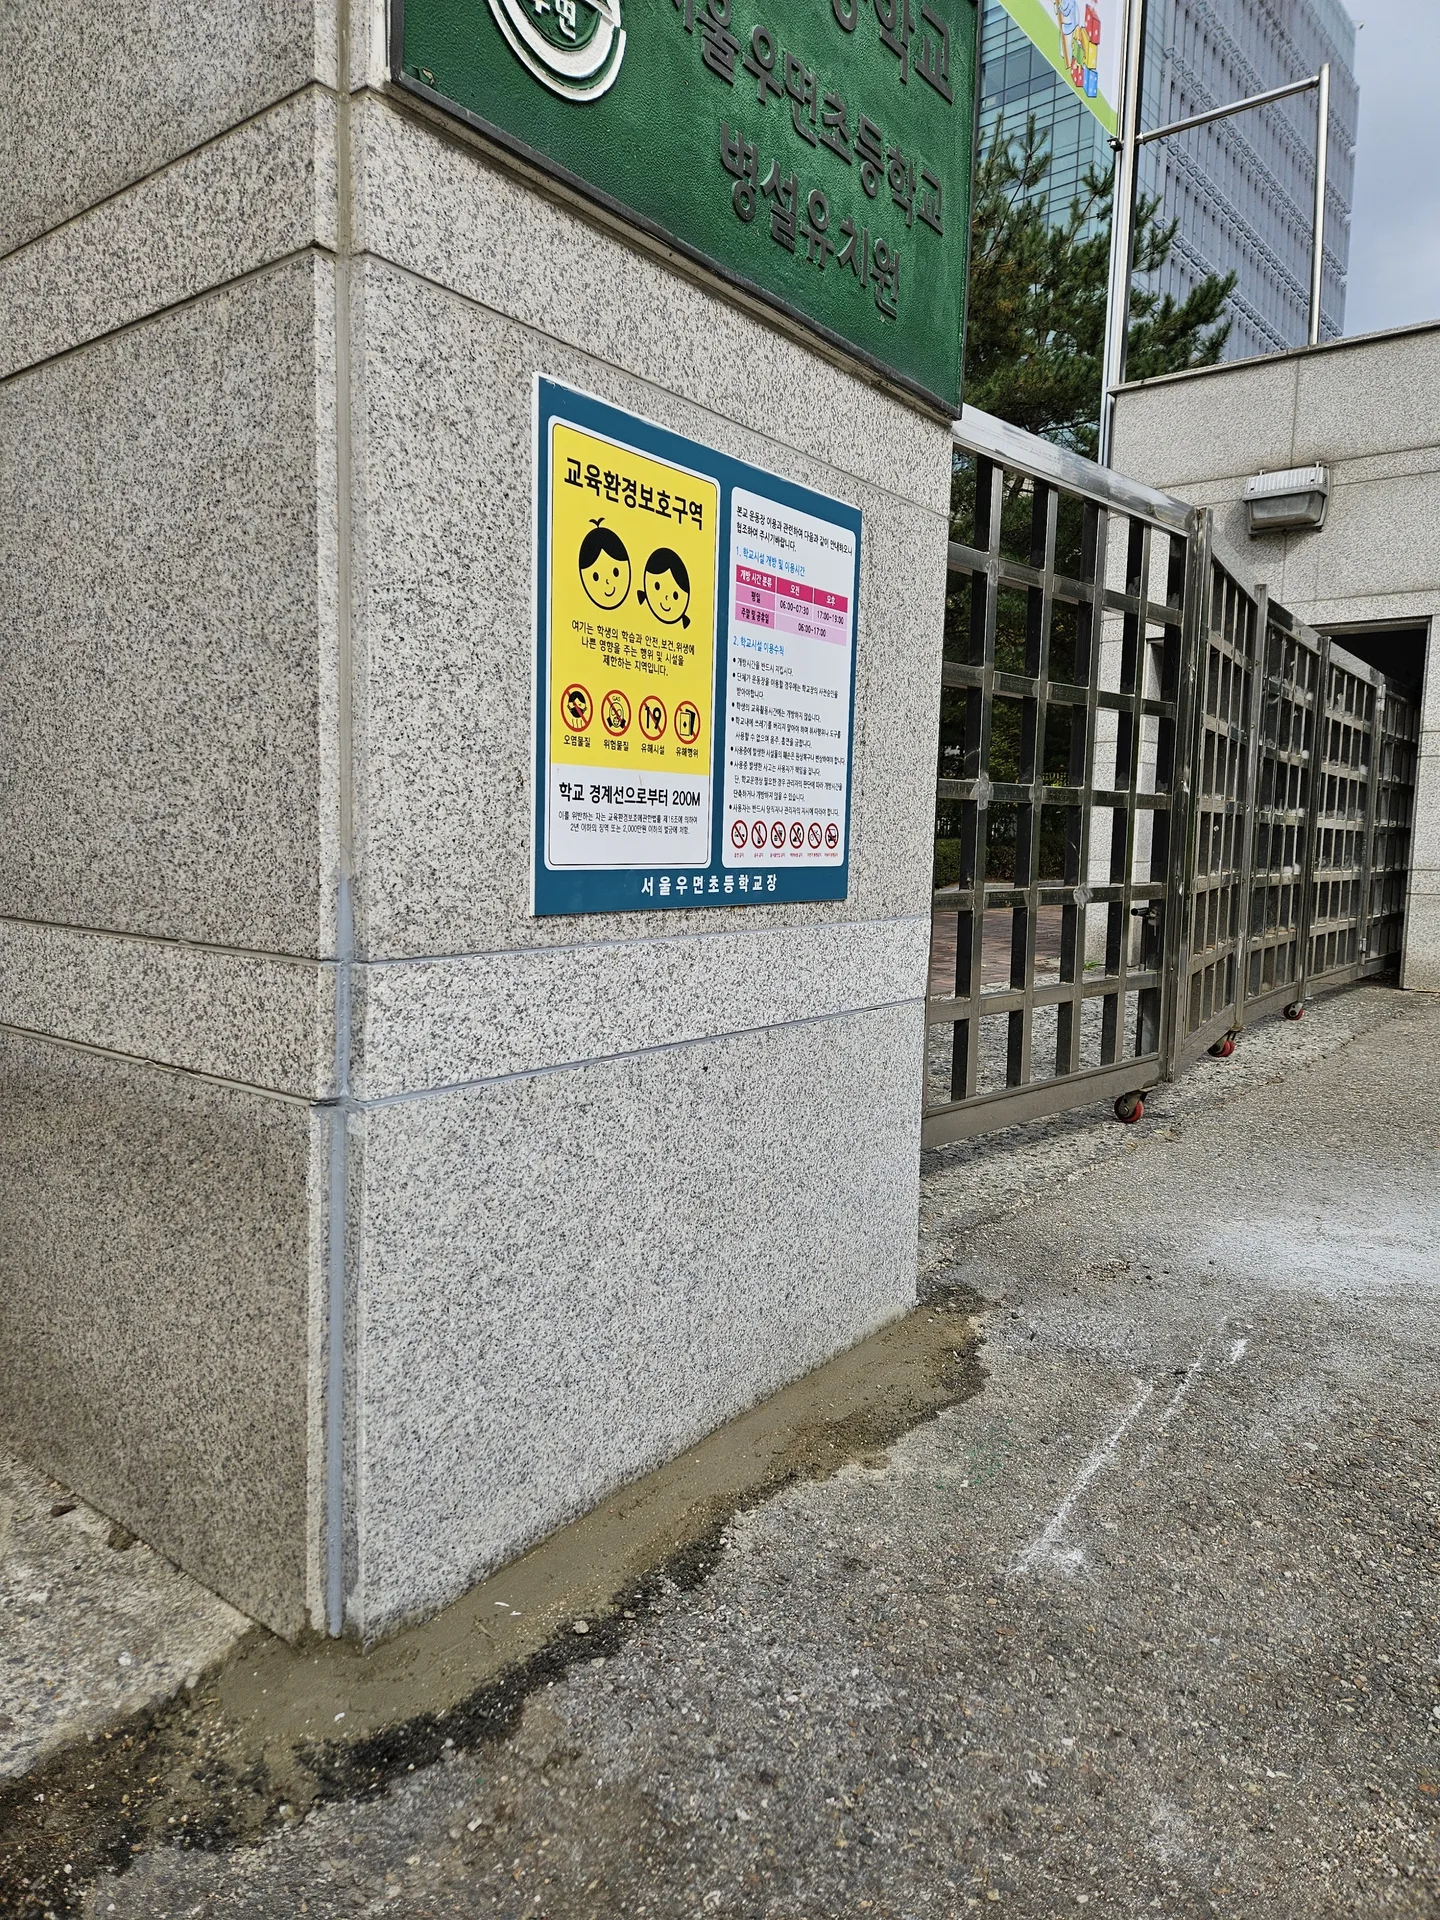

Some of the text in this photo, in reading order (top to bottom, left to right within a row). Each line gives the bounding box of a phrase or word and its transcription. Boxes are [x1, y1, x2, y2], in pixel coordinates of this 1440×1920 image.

[720, 120, 900, 320] 병설유치원
[564, 457, 703, 531] 교육환경보호구역
[736, 505, 748, 520] 본교
[749, 509, 766, 526] 운동장
[767, 516, 782, 532] 이용과
[782, 521, 803, 539] 관련하여
[804, 529, 819, 544] 다음과
[829, 538, 852, 555] 안내하오니
[736, 521, 758, 539] 협조하여
[736, 546, 805, 576] 1. 학교시설 개방 및 이용시간
[740, 569, 751, 581] 개방
[751, 572, 761, 585] 시간
[741, 607, 750, 619] 주말
[571, 619, 594, 635] 여기는
[597, 624, 619, 640] 학생의
[621, 629, 642, 645] 학습과
[581, 635, 684, 666] 나쁜 영향을 주는 행위 및 시설을
[733, 635, 784, 656] 2. 학교시설 이용수칙
[602, 653, 668, 676] 제한하는 지역입니다.
[644, 705, 661, 730] 19
[563, 734, 591, 748] 오염물질
[603, 738, 629, 751] 위험물질
[640, 742, 665, 755] 유해시설
[675, 746, 698, 758] 유해행위
[558, 781, 700, 806] 학교 경계선으로부터 200M
[558, 811, 569, 819] 이를
[571, 811, 593, 820] 위반하는
[595, 812, 606, 821] 자는
[570, 823, 579, 831] 2년
[580, 823, 597, 832] 이하의
[599, 823, 609, 832] 징역
[611, 824, 621, 832] 또는
[647, 825, 662, 833] 이하의
[641, 874, 777, 896] 서울우면초등학교장
